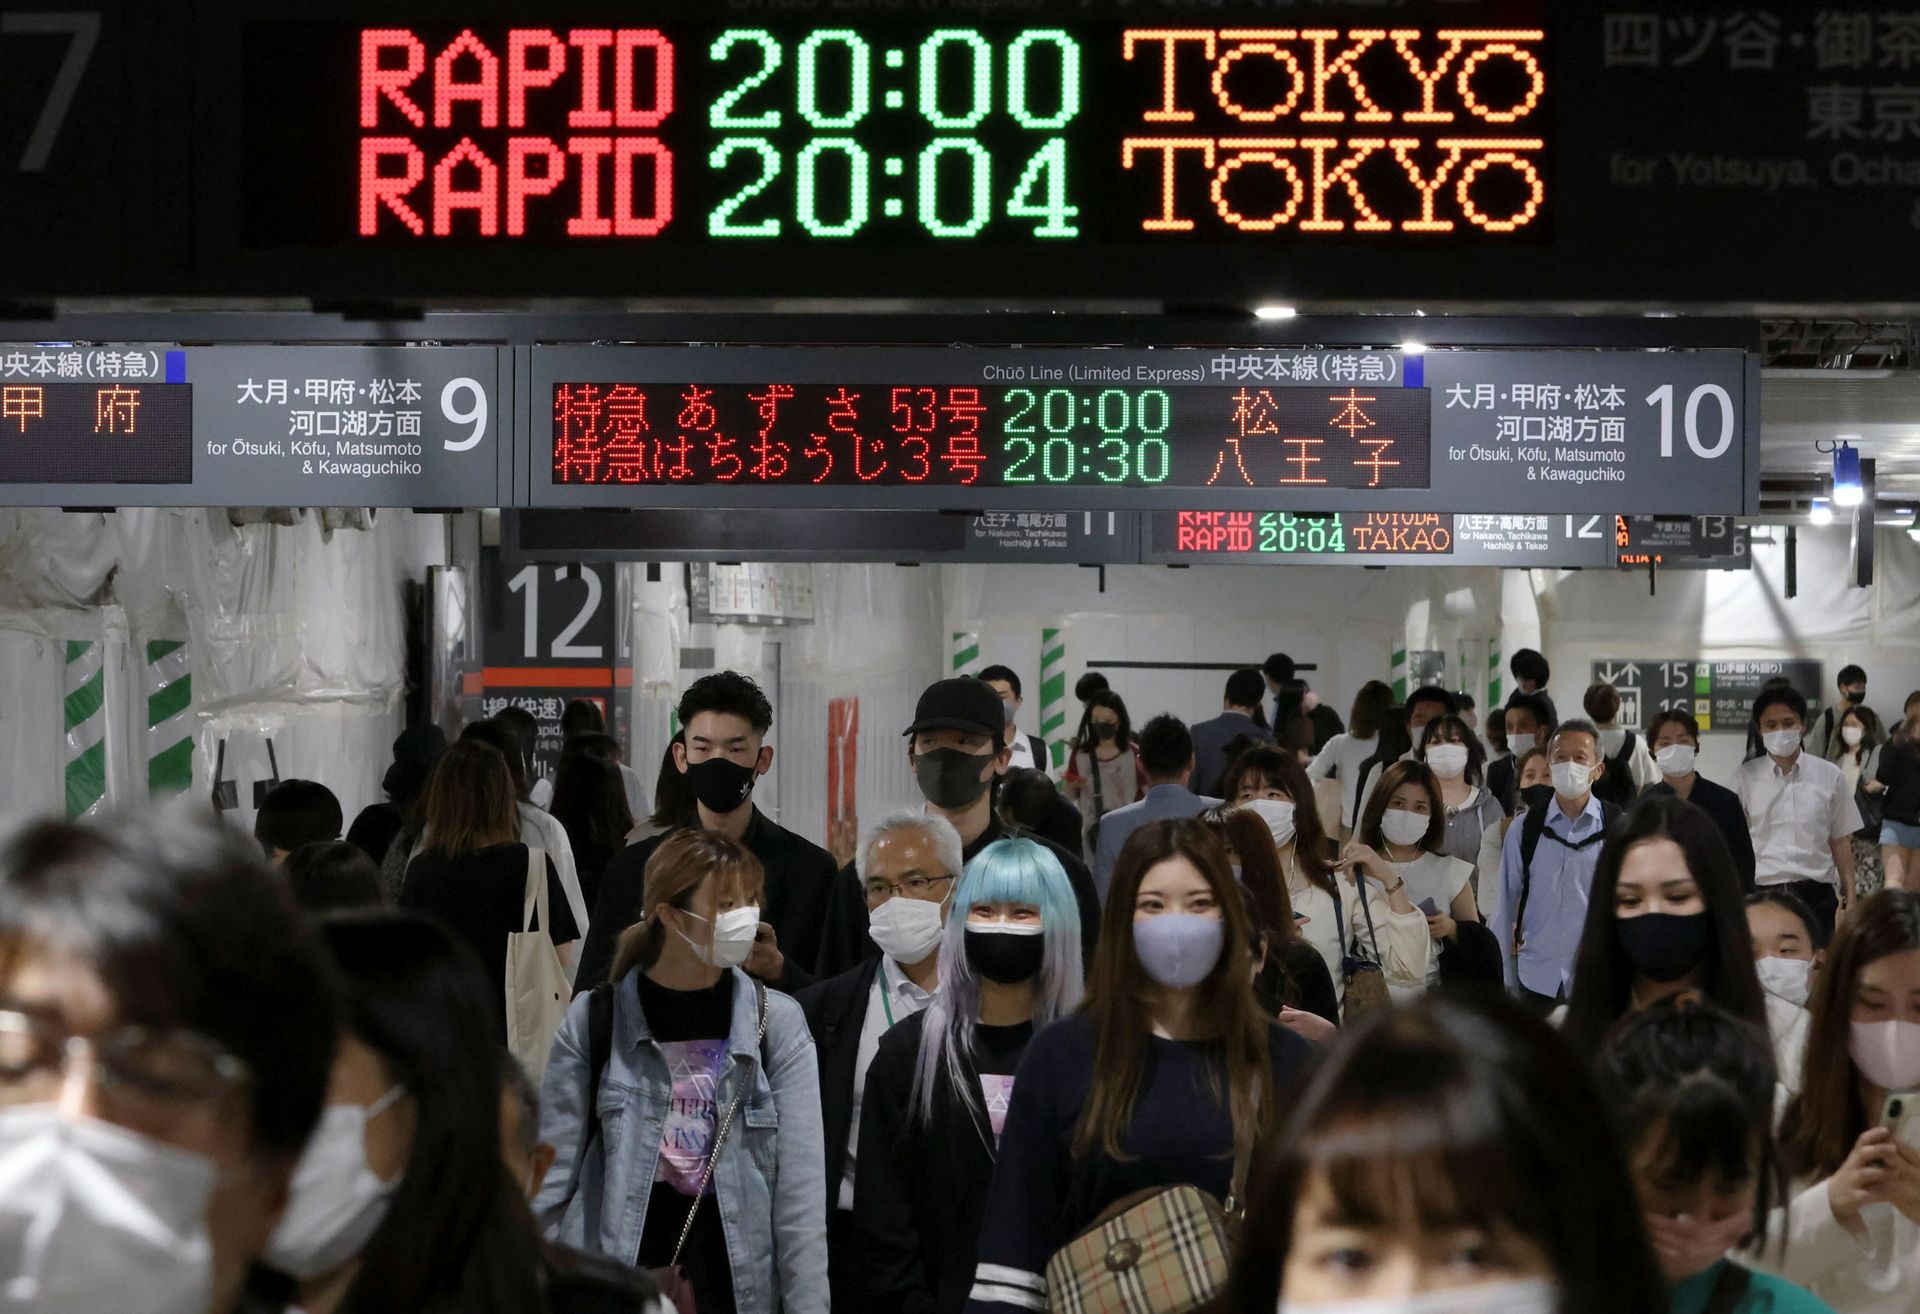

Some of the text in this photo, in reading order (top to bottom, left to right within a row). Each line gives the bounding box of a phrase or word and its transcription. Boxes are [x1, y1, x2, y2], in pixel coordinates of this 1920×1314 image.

[1, 11, 101, 172] 7
[361, 29, 674, 128] RAPID
[710, 29, 1080, 128] 20:00
[360, 137, 672, 236] RAPID
[709, 137, 1078, 237] 20:04
[1031, 366, 1062, 379] Line
[1069, 365, 1130, 381] (Limited
[1137, 365, 1204, 383] Express)
[1210, 353, 1397, 382] 中央本線(特急)
[289, 410, 421, 436] 河口湖方面
[441, 378, 487, 451] 9
[1005, 390, 1168, 433] 20:00
[1646, 384, 1733, 458] 10
[1496, 416, 1625, 442] 河口湖方面
[208, 441, 227, 454] for
[337, 441, 421, 455] Matsumoto
[1004, 438, 1168, 482] 20:30
[1208, 439, 1399, 486] 八王子
[1449, 447, 1465, 460] for
[1556, 448, 1625, 461] Matsumoto
[303, 460, 421, 477] & Kawaguchiko
[1527, 467, 1624, 484] & Kawaguchiko
[1178, 527, 1450, 551] RAPID 20:04 TAKAO
[508, 565, 602, 658] 12
[1659, 662, 1688, 688] 15
